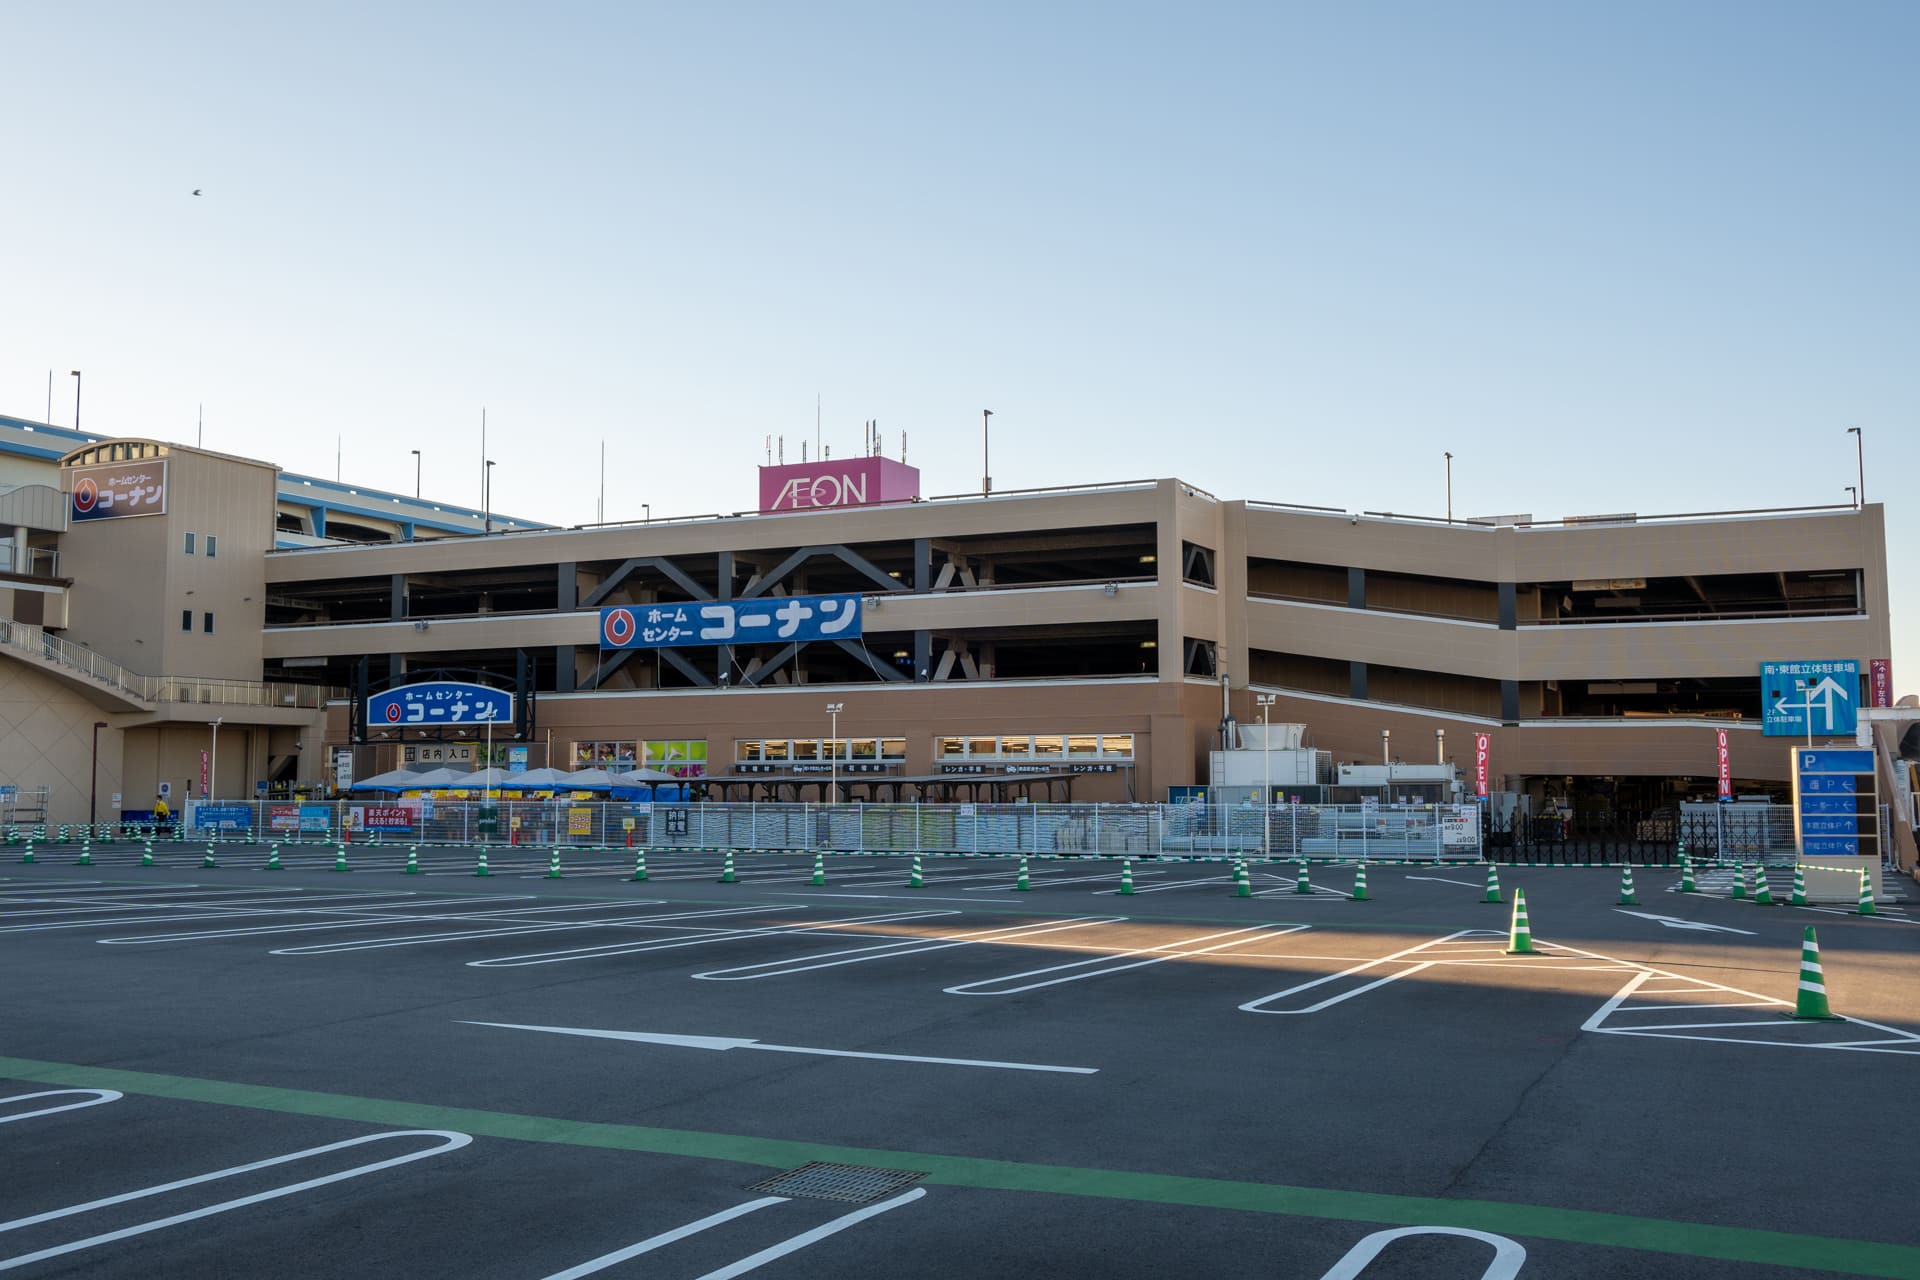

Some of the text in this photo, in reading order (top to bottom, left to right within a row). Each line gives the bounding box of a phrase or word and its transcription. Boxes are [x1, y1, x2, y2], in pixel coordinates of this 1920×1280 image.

[108, 475, 152, 486] ホームセンター
[98, 485, 162, 508] コーナン
[648, 608, 687, 624] ホーム
[700, 599, 857, 640] コーナン
[642, 626, 693, 642] センター
[405, 690, 473, 701] ホームセンター
[407, 701, 493, 721] コーナン
[449, 749, 469, 759] 入口
[1804, 754, 1816, 769] P
[1478, 736, 1487, 795] OPEN
[1720, 732, 1729, 794] OPEN
